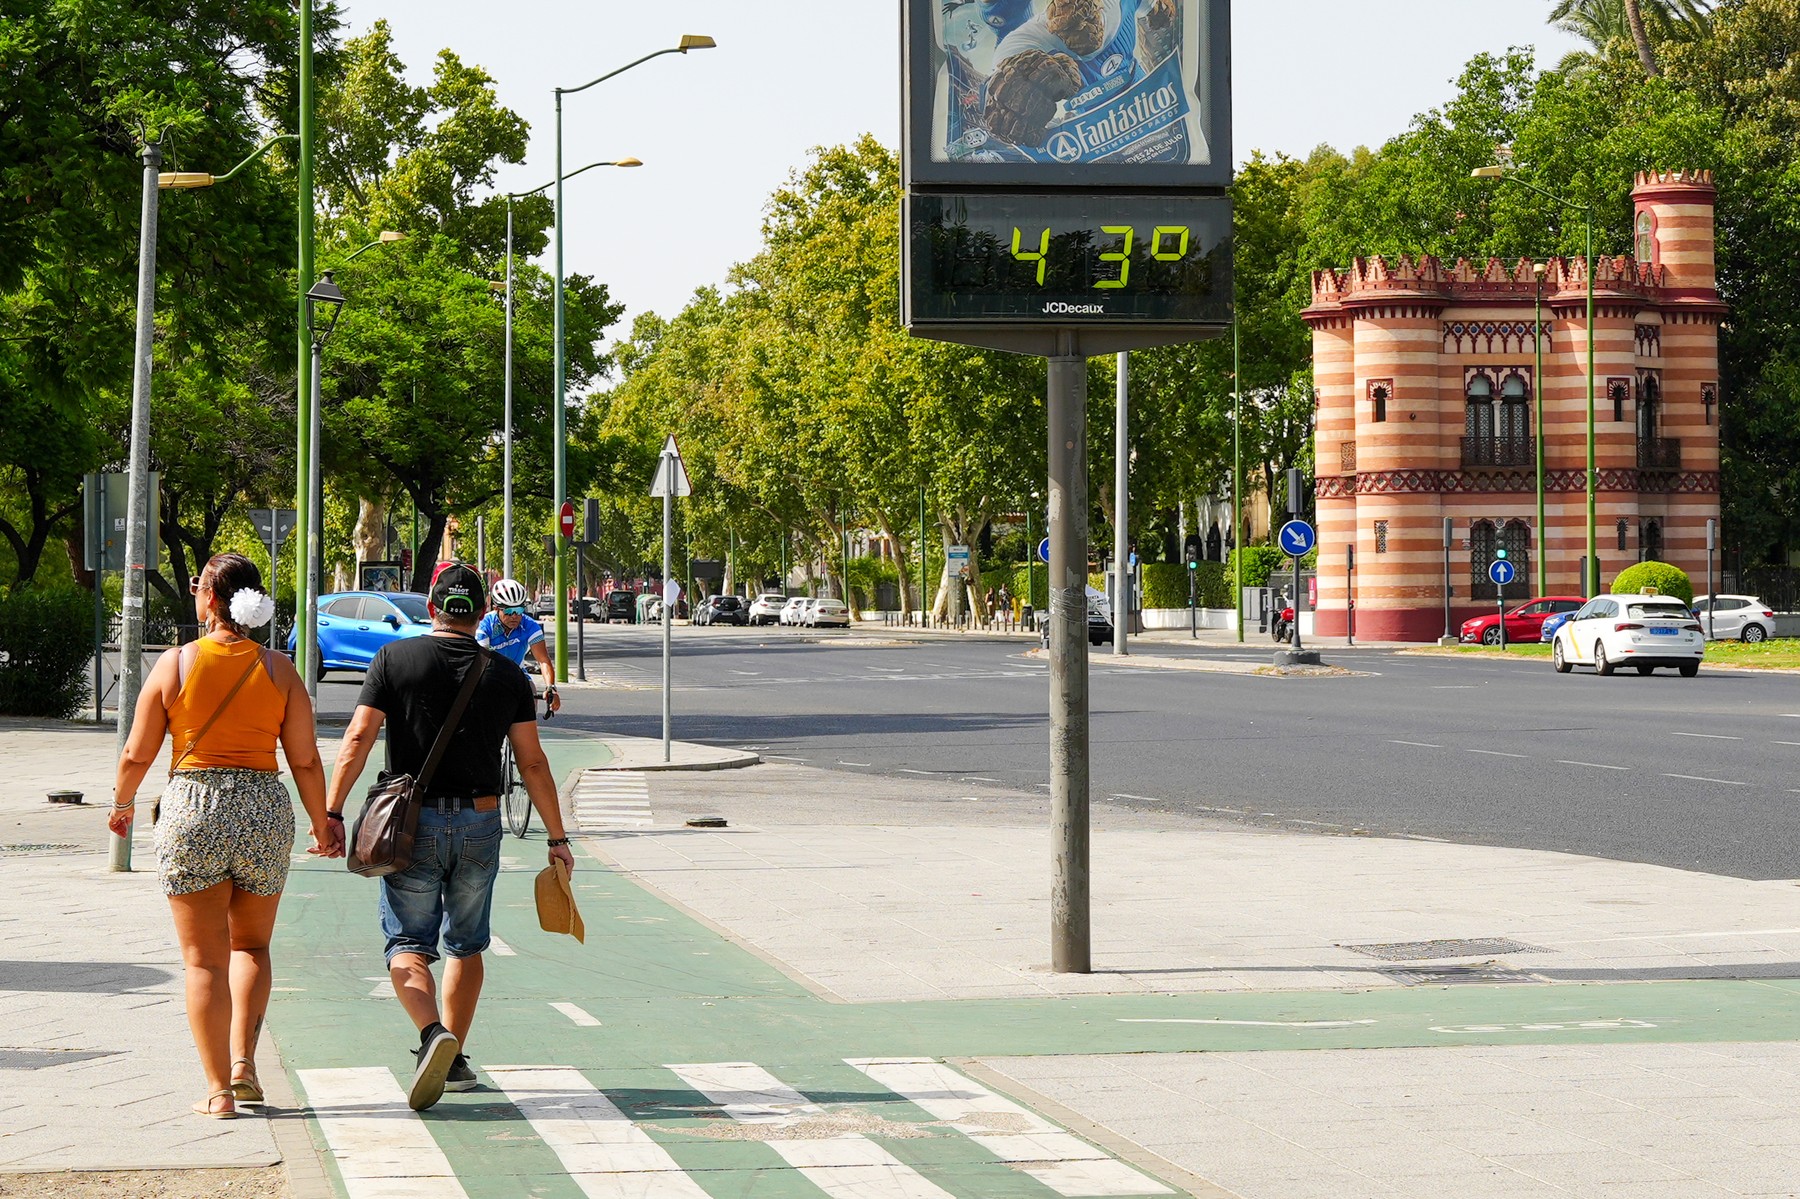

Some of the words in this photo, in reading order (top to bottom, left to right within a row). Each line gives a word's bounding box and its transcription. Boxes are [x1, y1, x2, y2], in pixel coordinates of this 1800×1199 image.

[1070, 87, 1102, 108] MARVEL
[1075, 82, 1178, 154] Fantásticos
[1094, 128, 1144, 155] PRIMEROS
[1148, 108, 1178, 128] PASOS
[1144, 147, 1155, 156] 24
[1153, 142, 1164, 151] DE
[1163, 133, 1183, 147] JULIO
[1042, 302, 1104, 314] JCDecaux
